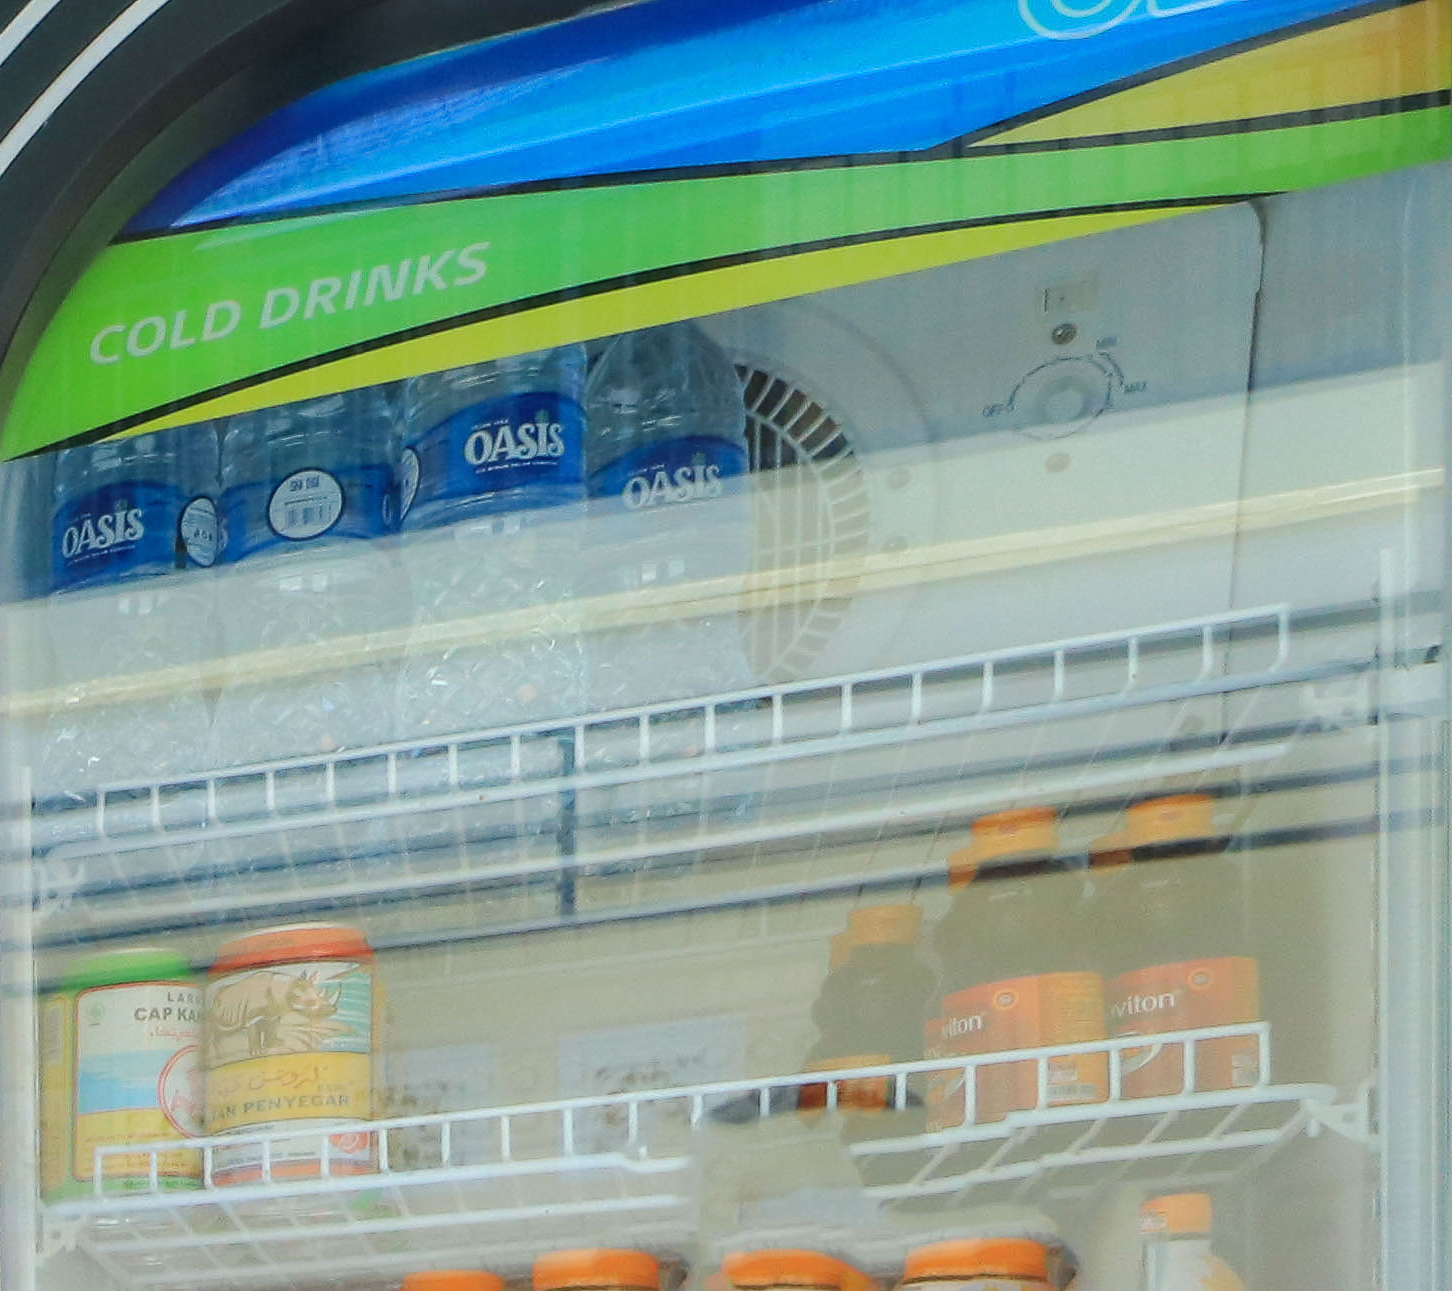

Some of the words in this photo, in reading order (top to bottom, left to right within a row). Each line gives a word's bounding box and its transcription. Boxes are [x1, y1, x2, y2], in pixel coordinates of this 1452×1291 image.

[90, 300, 241, 365] COLD
[259, 242, 490, 329] DRINKS
[464, 421, 566, 465] OASIS
[622, 464, 723, 509] OASIS
[61, 509, 144, 558] OASIS
[134, 1007, 172, 1021] CAP
[243, 1094, 349, 1115] PENYEGAR
